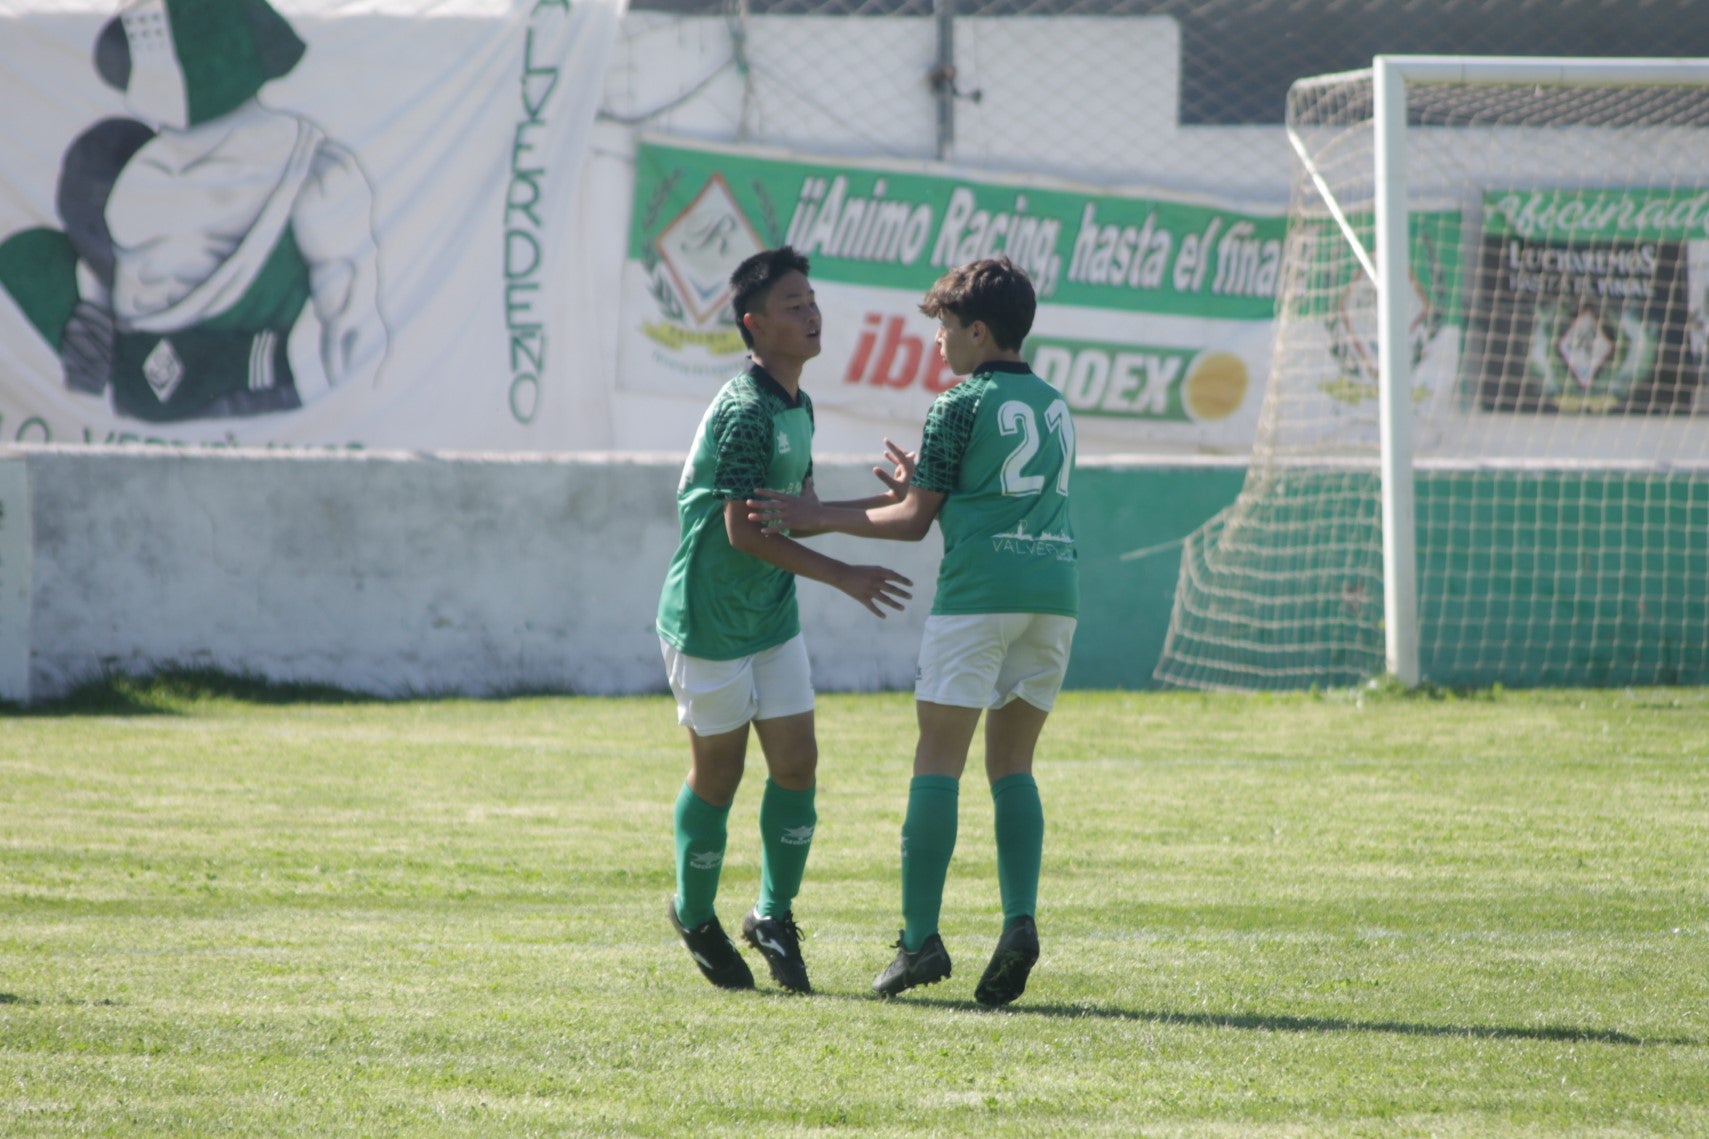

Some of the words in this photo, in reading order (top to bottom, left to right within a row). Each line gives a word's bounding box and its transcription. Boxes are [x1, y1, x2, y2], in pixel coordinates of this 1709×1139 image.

[1067, 201, 1172, 290] hasta
[1173, 216, 1223, 292] el
[997, 398, 1075, 497] 21
